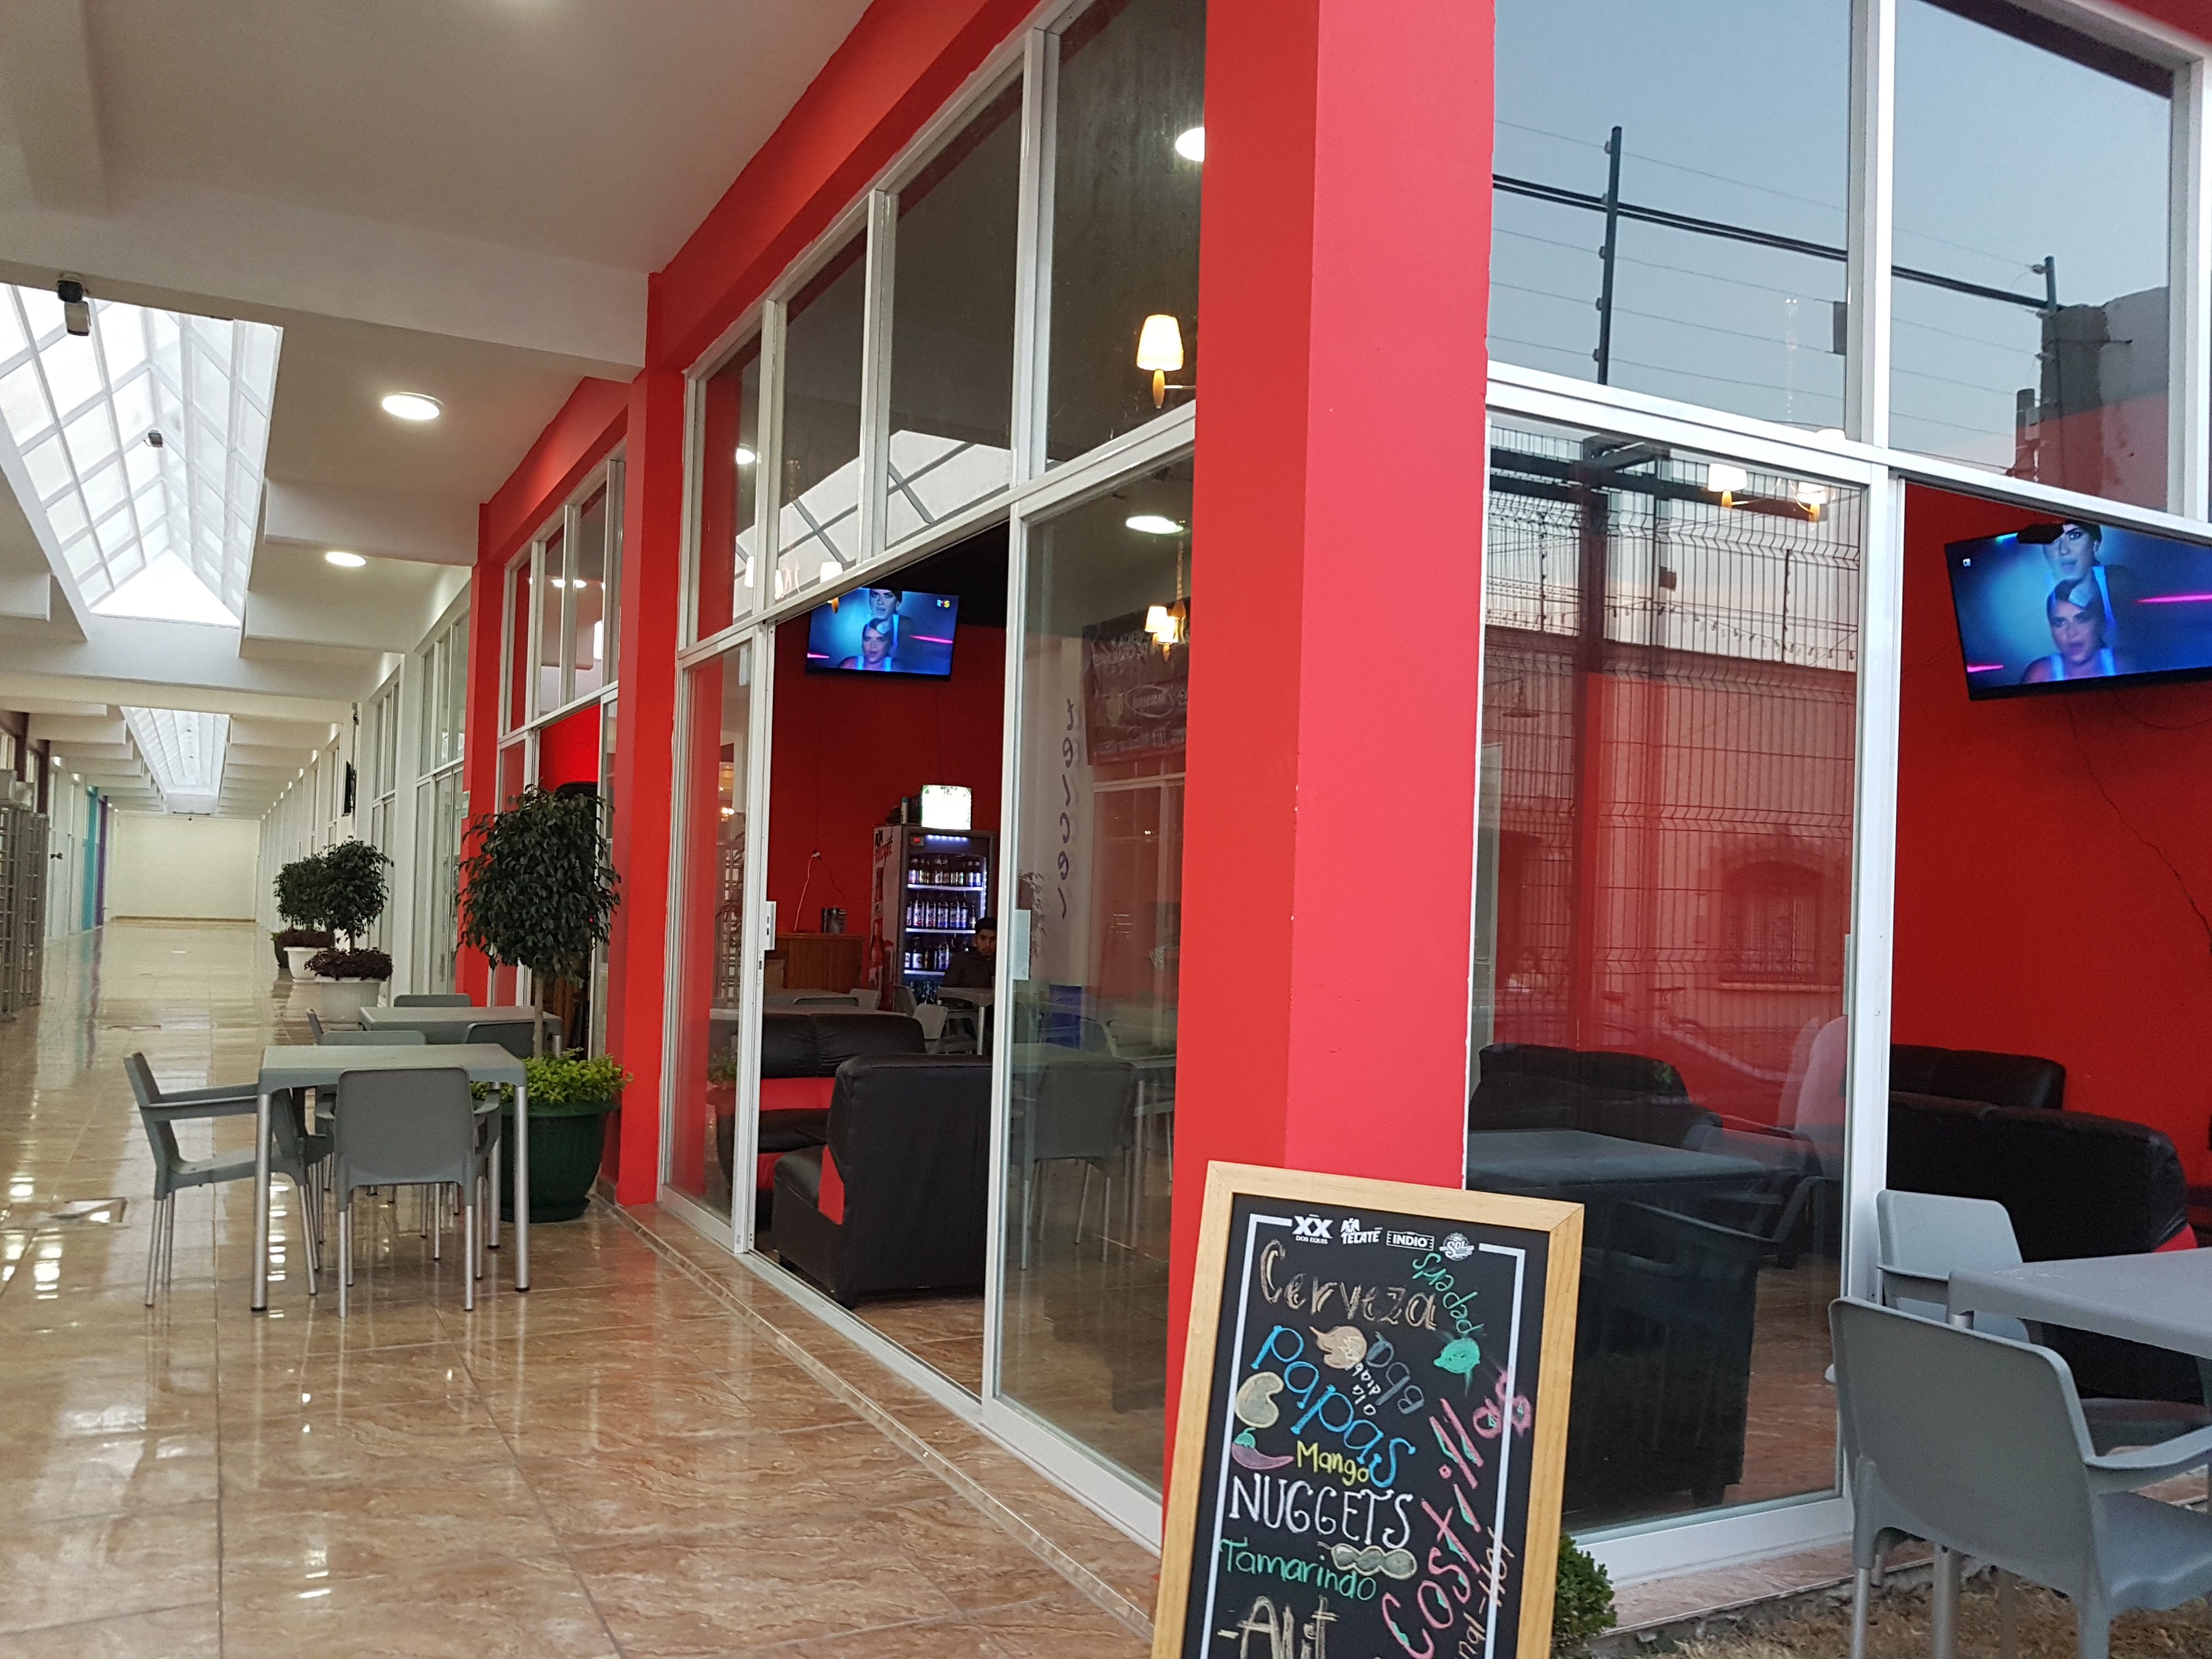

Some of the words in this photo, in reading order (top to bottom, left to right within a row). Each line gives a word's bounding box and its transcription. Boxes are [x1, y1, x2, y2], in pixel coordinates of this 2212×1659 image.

[1292, 1214, 1334, 1239] XX
[1341, 1228, 1382, 1244] TECATE
[1392, 1234, 1427, 1248] INDIO
[1260, 1239, 1437, 1331] Cerveza
[1296, 1440, 1370, 1486] Mango
[1229, 1473, 1415, 1548] NUGGETS
[1219, 1536, 1377, 1601] Tamarindo
